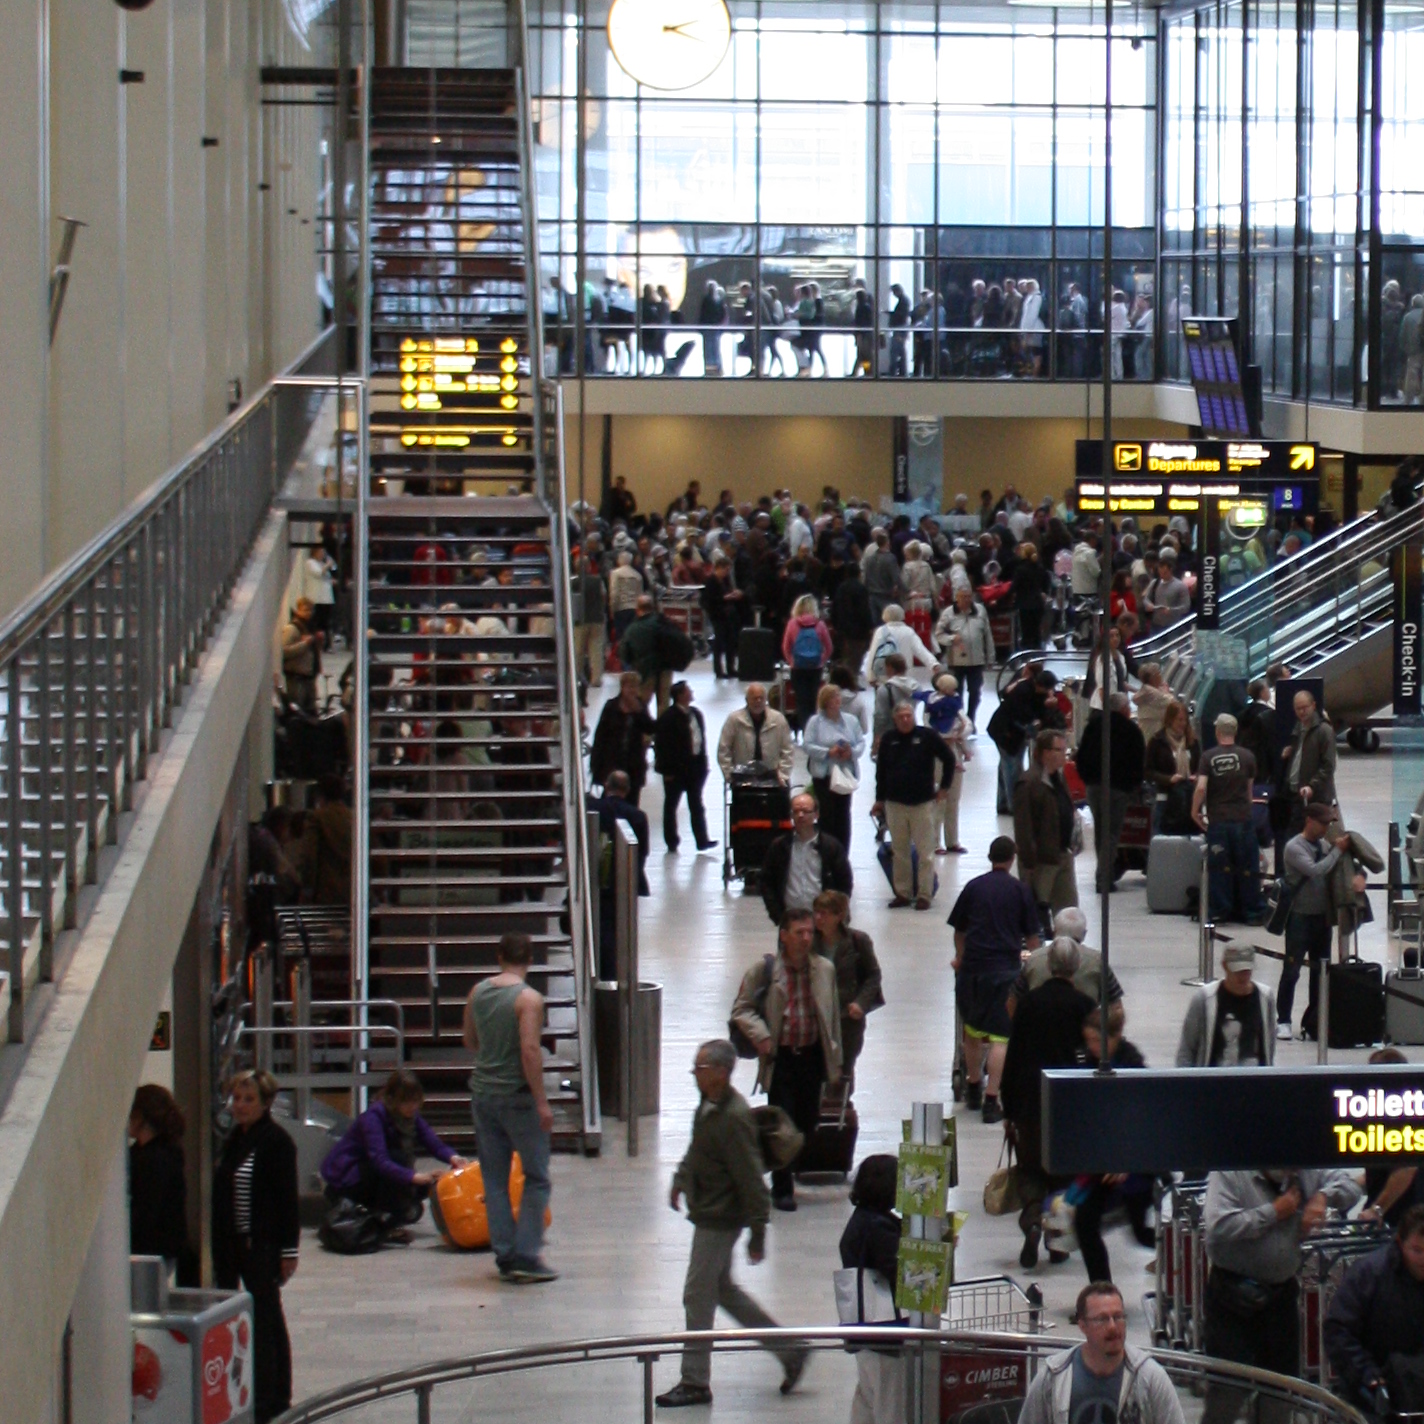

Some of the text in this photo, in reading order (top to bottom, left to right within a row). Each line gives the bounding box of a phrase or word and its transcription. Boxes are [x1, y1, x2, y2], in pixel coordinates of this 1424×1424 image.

[1149, 459, 1220, 474] Departures
[1203, 555, 1217, 616] Check-in
[1402, 622, 1418, 696] Check-in
[965, 1364, 1019, 1384] CIMBER
